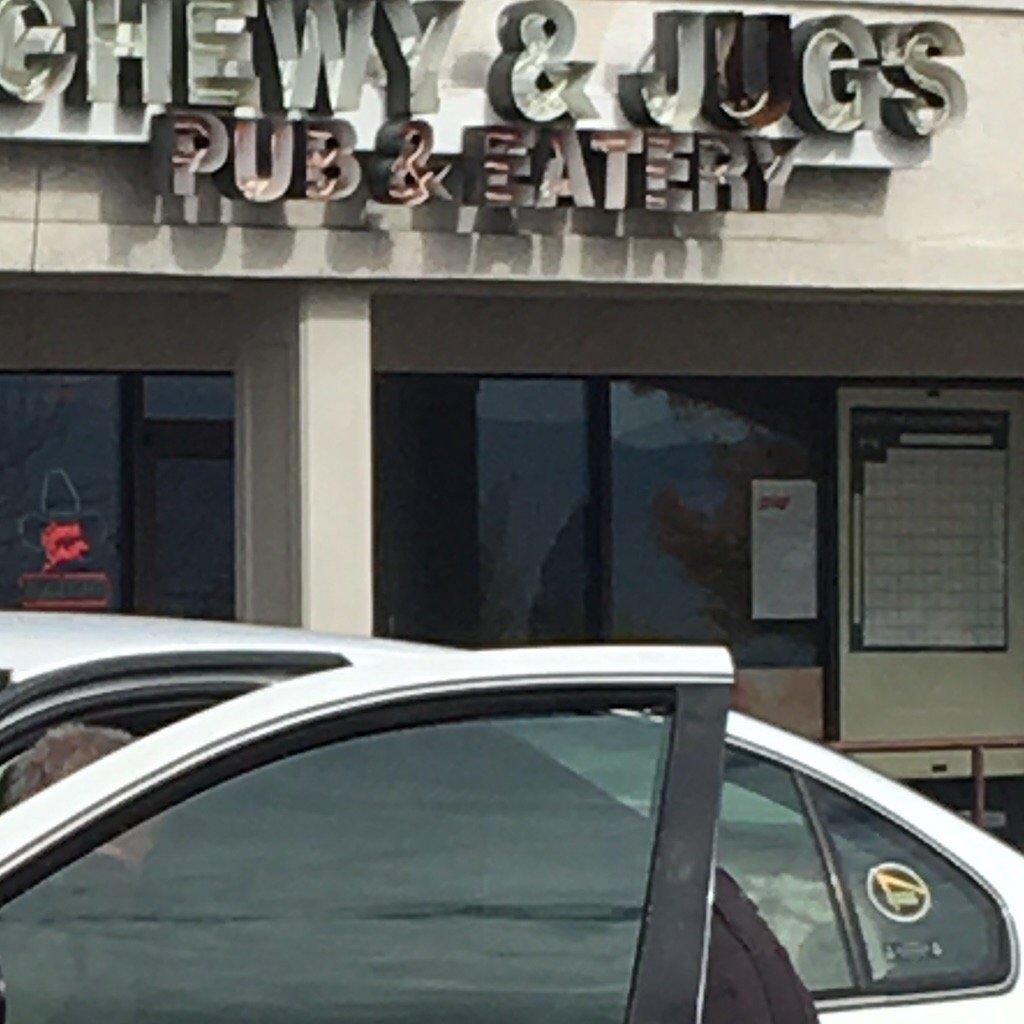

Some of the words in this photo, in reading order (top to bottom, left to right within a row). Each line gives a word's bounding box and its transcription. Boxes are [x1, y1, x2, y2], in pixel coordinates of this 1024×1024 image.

[488, 0, 600, 122] &
[618, 12, 968, 137] JUGS
[154, 112, 364, 202] PUB
[375, 119, 454, 206] &
[464, 125, 802, 213] EATERY
